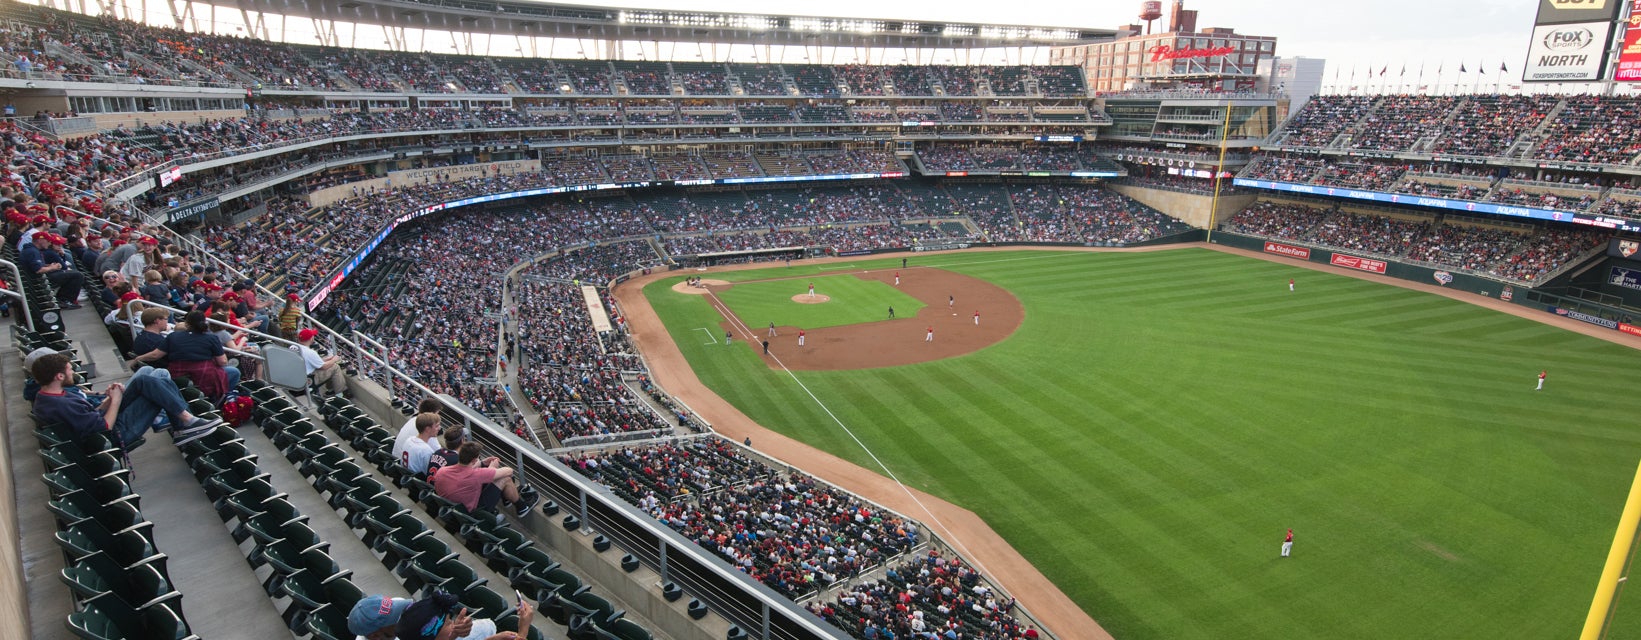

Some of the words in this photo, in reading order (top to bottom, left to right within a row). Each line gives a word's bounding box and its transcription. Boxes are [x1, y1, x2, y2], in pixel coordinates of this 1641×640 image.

[1553, 31, 1584, 43] FOX
[1538, 54, 1588, 67] NORTH
[406, 169, 445, 179] WELCOME
[459, 164, 490, 173] TARGET
[498, 162, 521, 170] FIELD
[1418, 197, 1447, 208] AQUAFINA
[175, 208, 193, 220] DELTA
[1495, 206, 1530, 217] AQUAFINA
[1567, 310, 1600, 325] COMMUNITY
[1600, 318, 1618, 329] FUND
